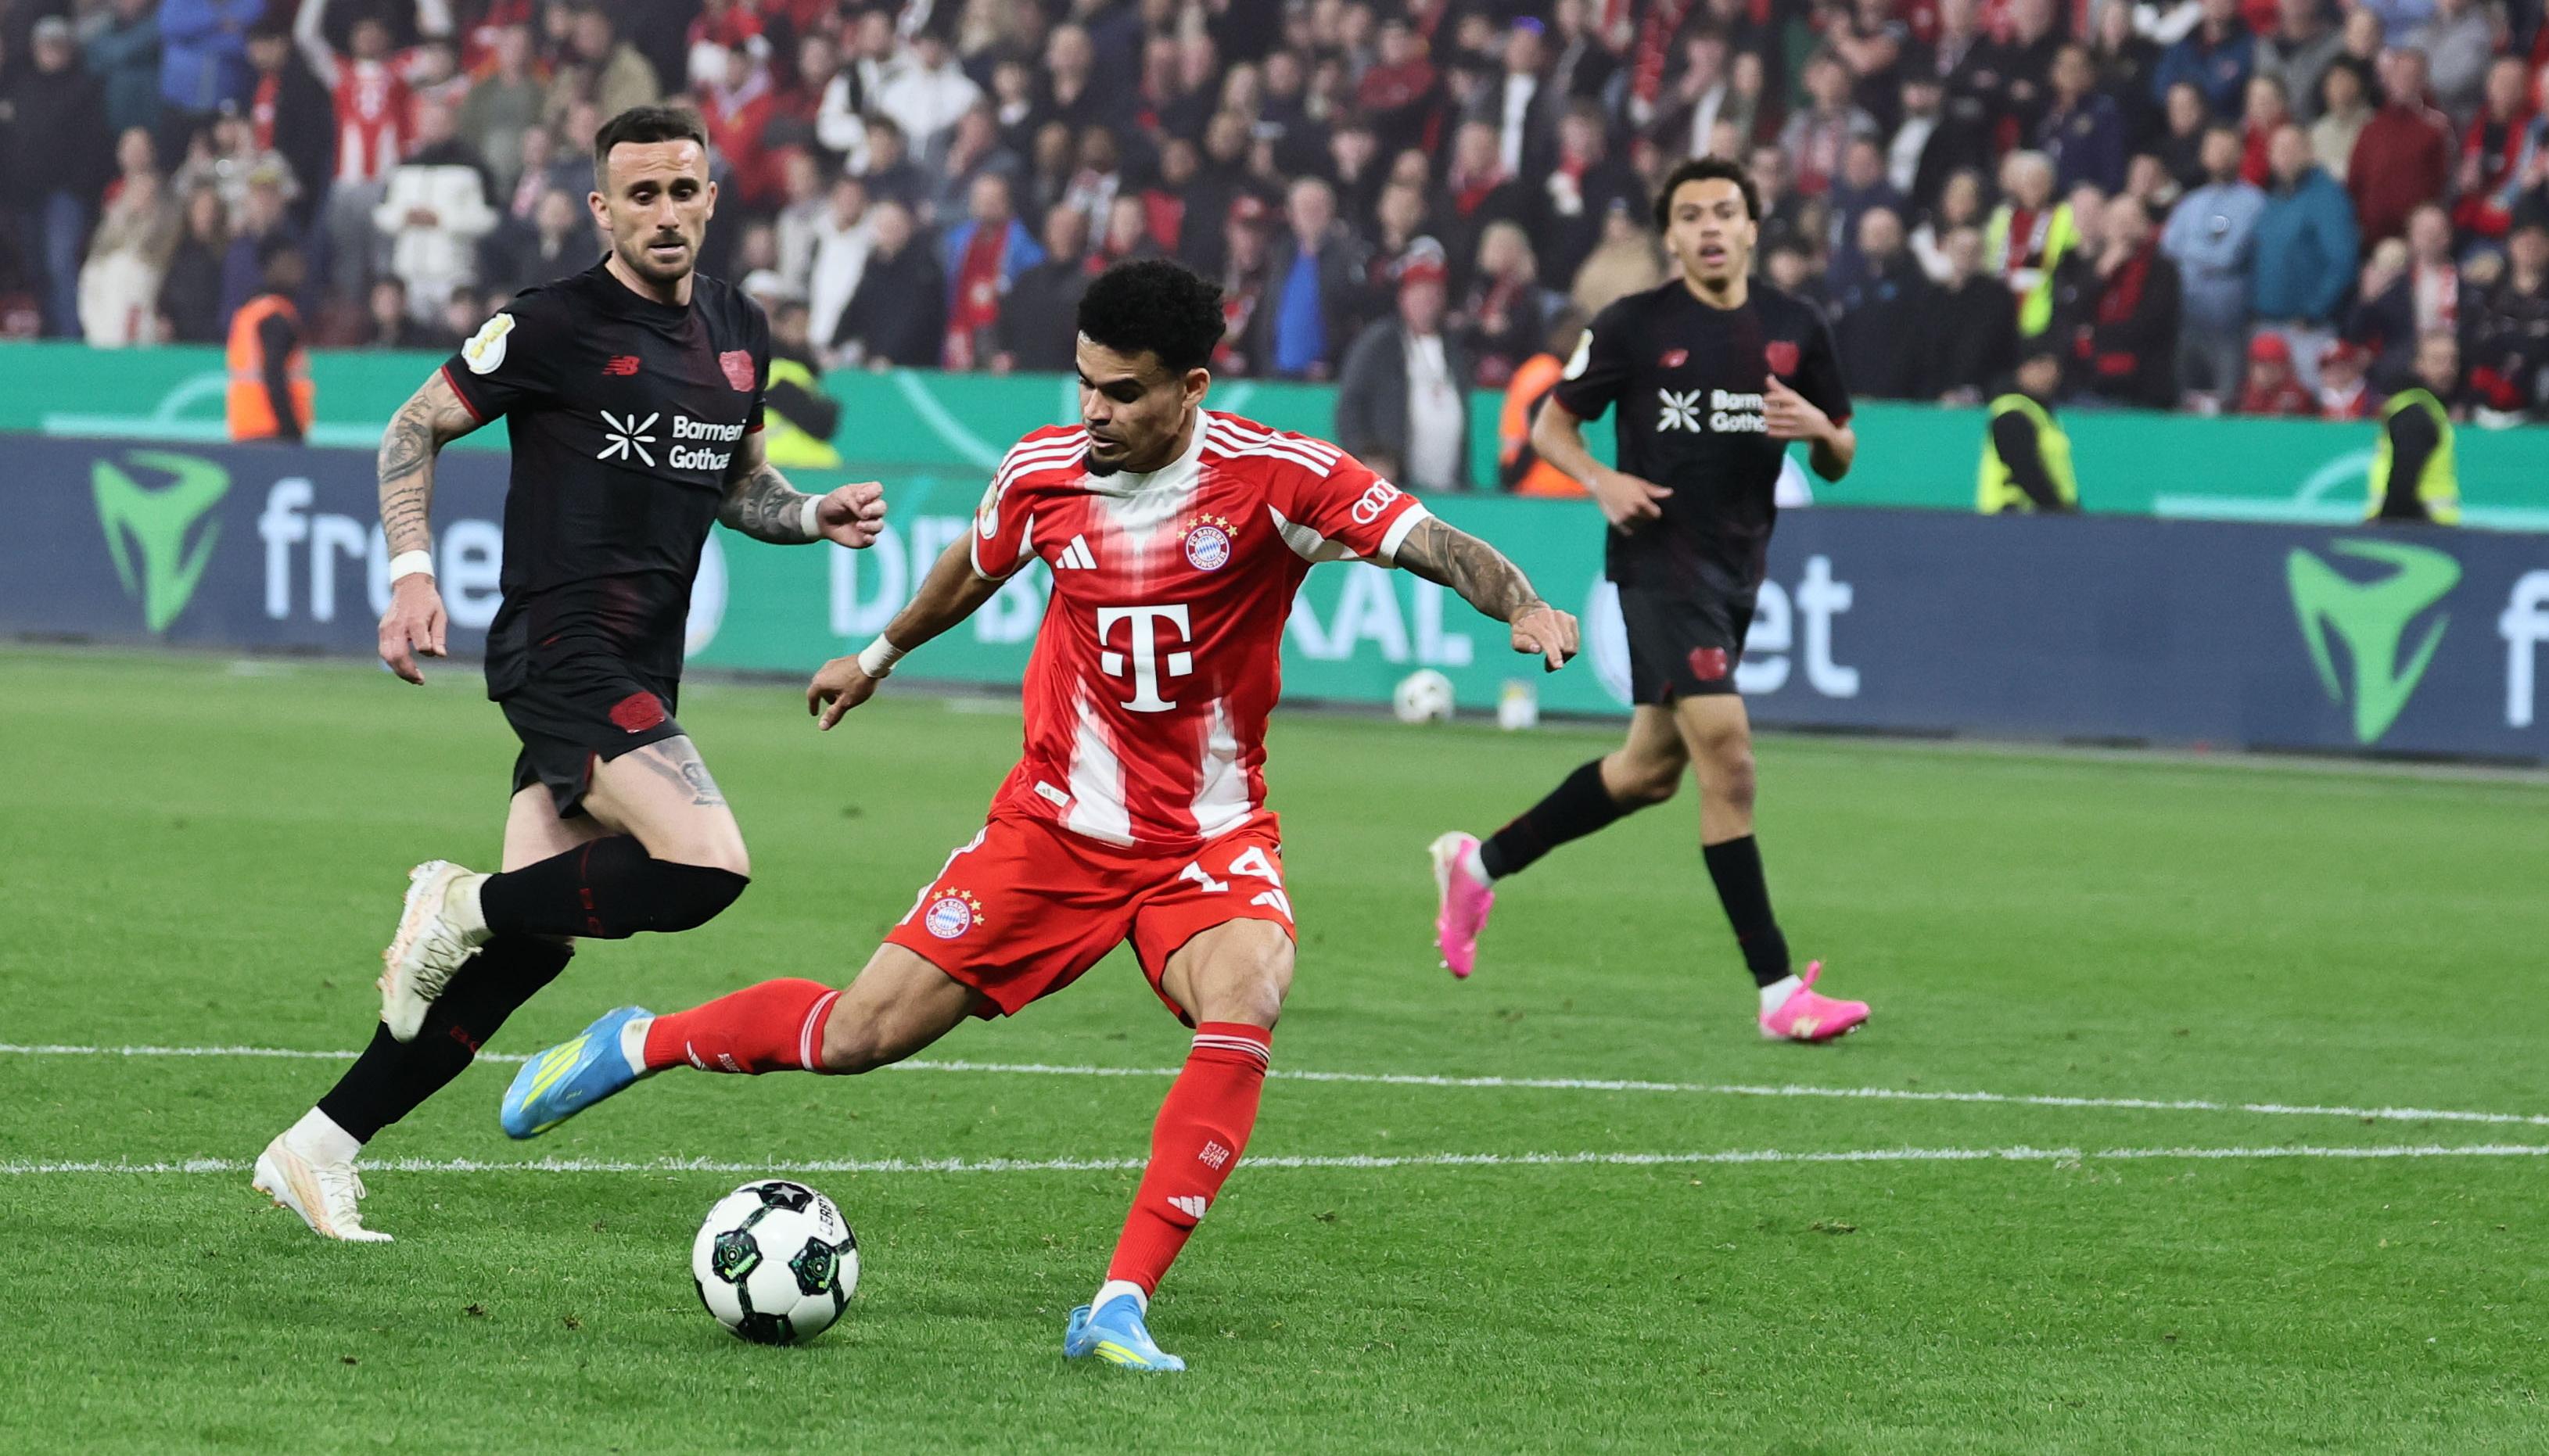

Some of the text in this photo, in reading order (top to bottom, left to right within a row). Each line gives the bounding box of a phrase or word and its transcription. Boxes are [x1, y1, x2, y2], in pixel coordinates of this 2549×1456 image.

[1711, 389, 1767, 411] Barm
[1097, 604, 1193, 712] T
[1178, 845, 1282, 893] 14
